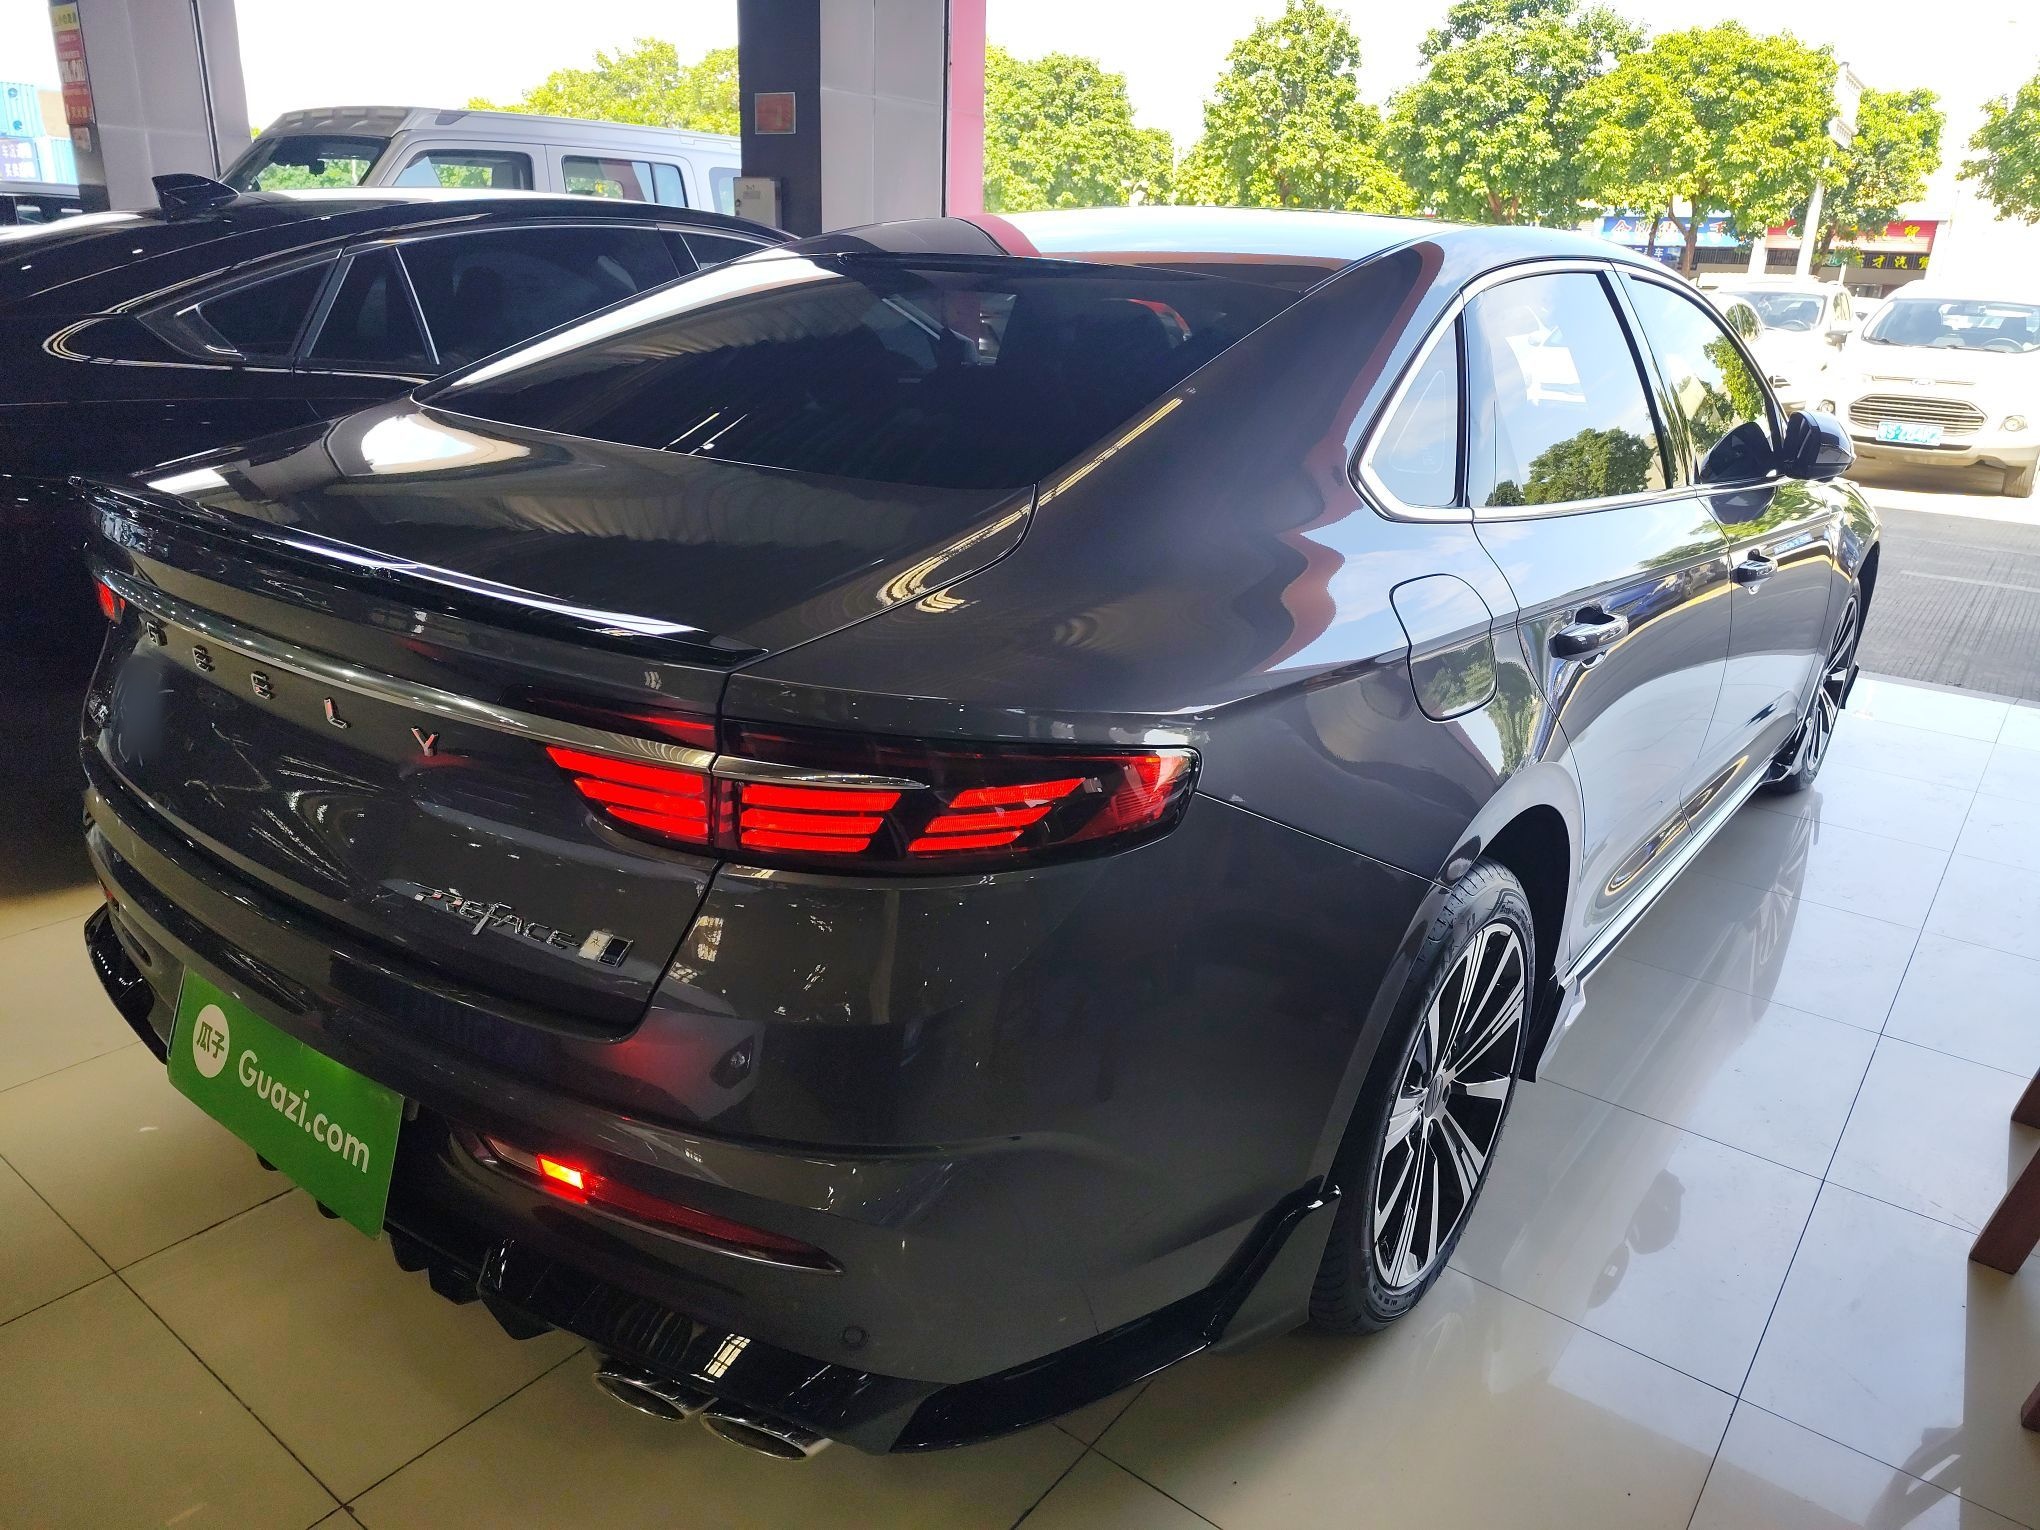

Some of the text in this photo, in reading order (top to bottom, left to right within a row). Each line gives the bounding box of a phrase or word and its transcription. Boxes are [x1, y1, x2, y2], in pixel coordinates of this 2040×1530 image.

[146, 620, 440, 757] GEELY
[196, 1020, 225, 1059] 瓜子
[238, 1049, 370, 1174] Guazi.com
